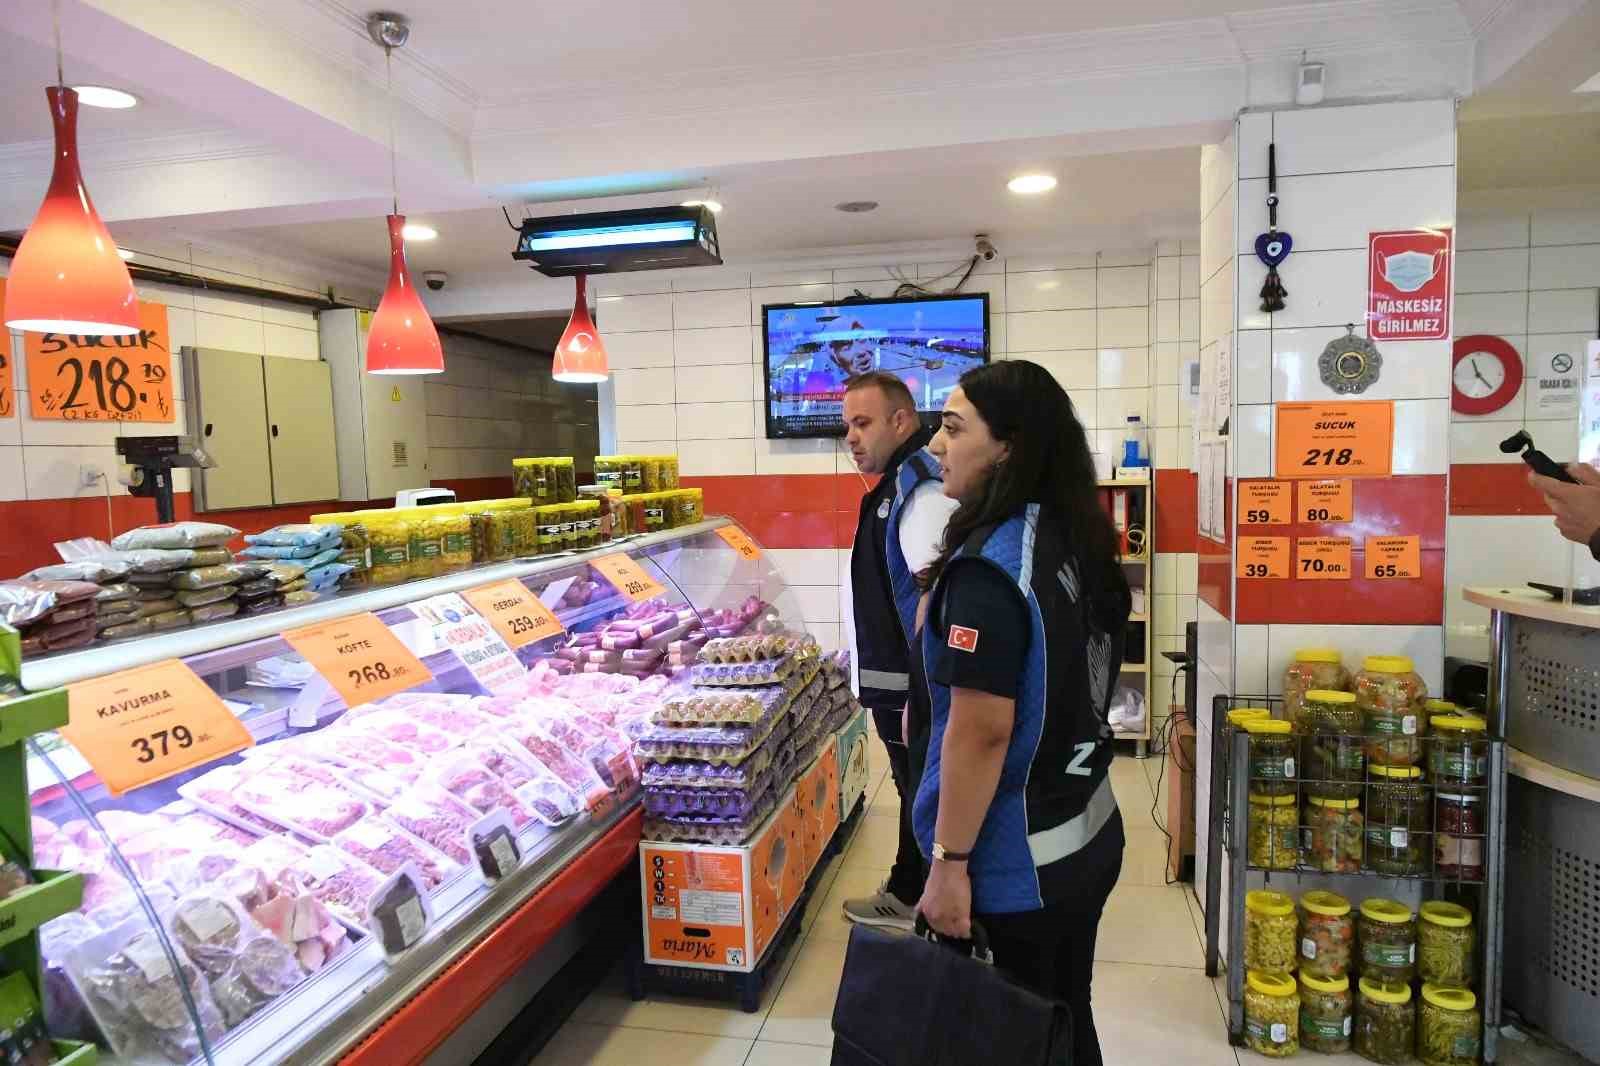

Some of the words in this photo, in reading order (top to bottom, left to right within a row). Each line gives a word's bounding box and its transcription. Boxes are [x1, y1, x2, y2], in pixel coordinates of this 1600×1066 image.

[1376, 295, 1442, 314] MASKESİZ
[1378, 316, 1440, 333] GİRİLMEZ
[1314, 421, 1357, 430] SUCUK
[96, 689, 173, 719] KAVURMA
[663, 938, 716, 960] Maria
